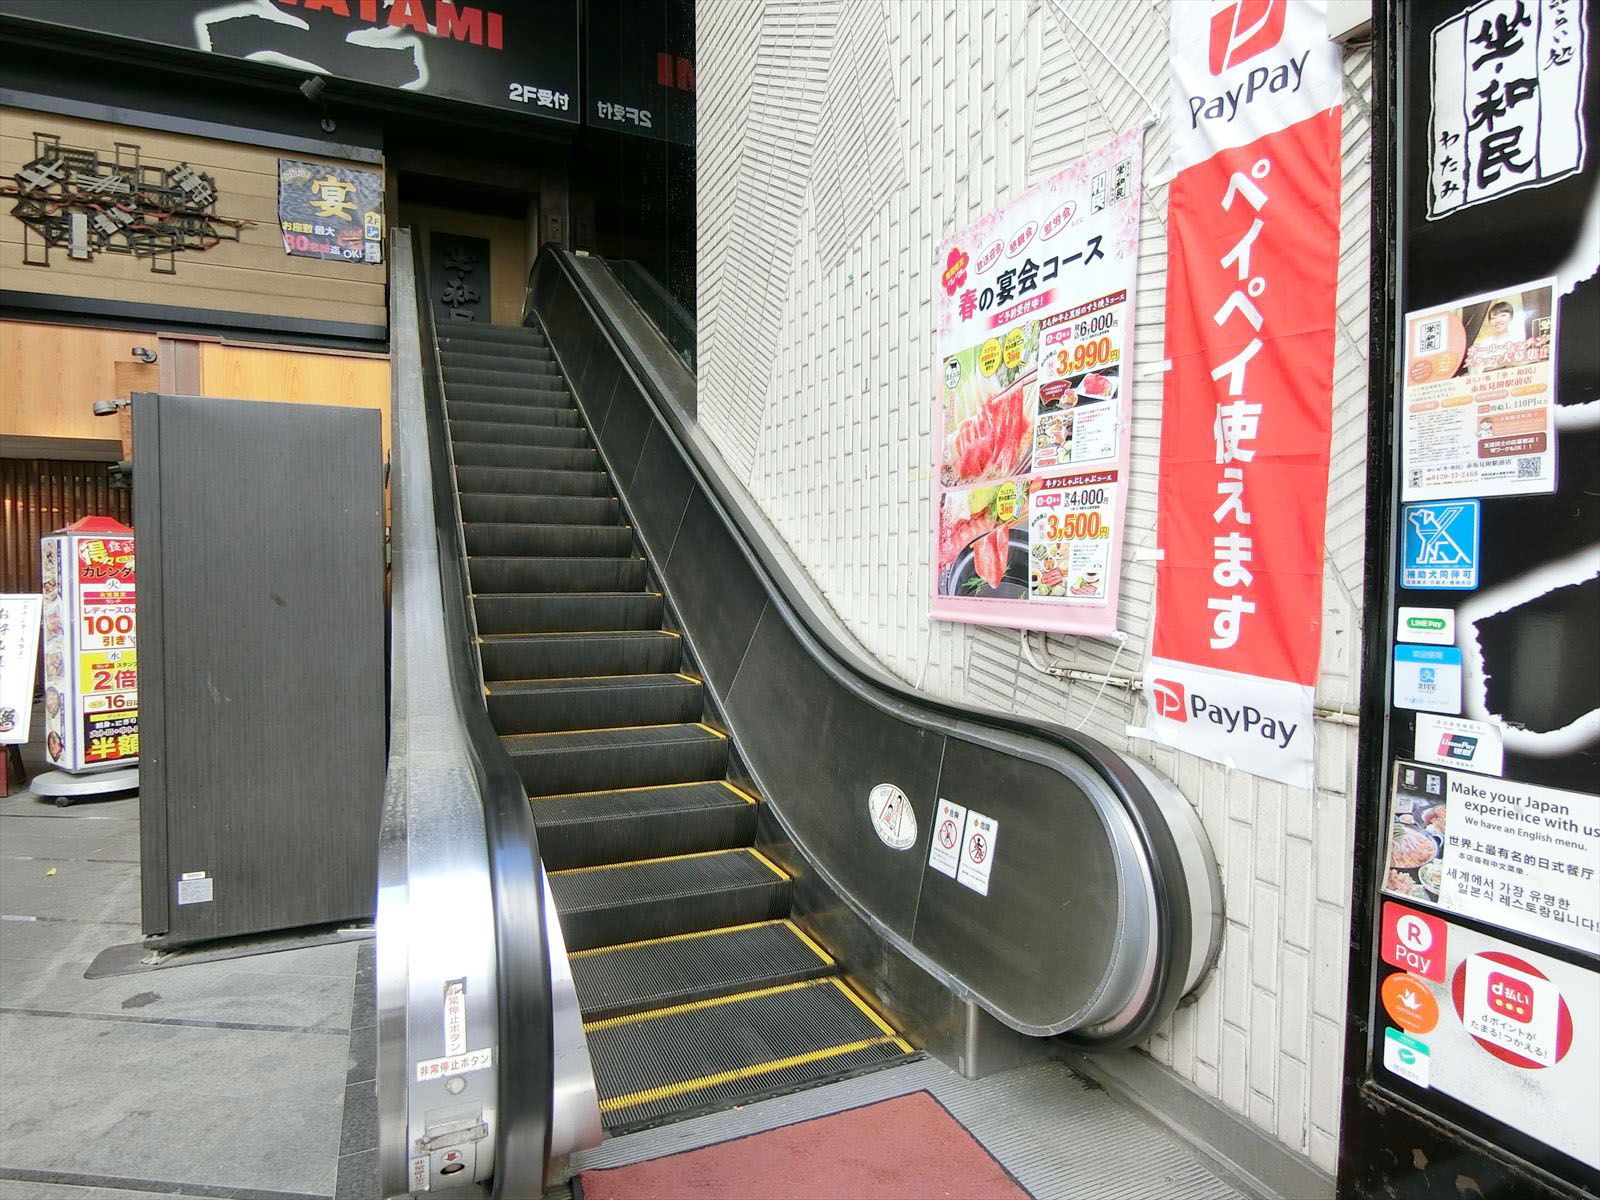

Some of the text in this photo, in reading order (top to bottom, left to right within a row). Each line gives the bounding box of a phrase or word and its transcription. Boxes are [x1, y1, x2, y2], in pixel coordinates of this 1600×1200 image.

[509, 83, 570, 111] 2F受付
[1188, 49, 1311, 130] PayPay
[1439, 131, 1460, 199] わたみ
[309, 174, 358, 221] 宴
[314, 225, 336, 237] 最大
[367, 216, 379, 224] 2F
[343, 250, 363, 259] OK!
[958, 234, 1105, 322] 春の宴会コース
[1080, 312, 1119, 337] 6,000円
[1056, 337, 1120, 375] 3,990円
[1207, 158, 1272, 650] ペイペイ使えます
[1045, 475, 1112, 488] 牛タンしゃぶしゃぶコース
[1070, 488, 1109, 506] 4,000円
[1047, 512, 1109, 540] 3,500円
[83, 566, 135, 578] カレンダ
[108, 580, 118, 589] 火
[1407, 570, 1472, 579] 補助犬同伴可
[1410, 619, 1443, 629] LINE Pay
[103, 635, 125, 646] 引き
[110, 652, 120, 660] 水
[94, 670, 136, 690] 2倍
[1190, 693, 1298, 749] PayPay
[91, 734, 139, 759] 半額
[1441, 738, 1476, 751] UnionPay
[1451, 782, 1569, 816] Make your Japan
[1464, 801, 1540, 825] experience
[1544, 815, 1579, 833] with
[1465, 816, 1588, 851] We have an English menu.
[1449, 836, 1595, 880] 世界上最有名的日式餐厅
[1446, 867, 1570, 911] 세계에서 가장 유명한
[1457, 883, 1494, 901] 일본식
[1408, 922, 1423, 945] R
[1395, 945, 1431, 973] Pay
[1490, 981, 1529, 1005] d払い
[448, 987, 464, 1051] 非常停止ボタン
[1481, 1013, 1536, 1040] dポイントが
[420, 1054, 489, 1076] 非常停止ボタン
